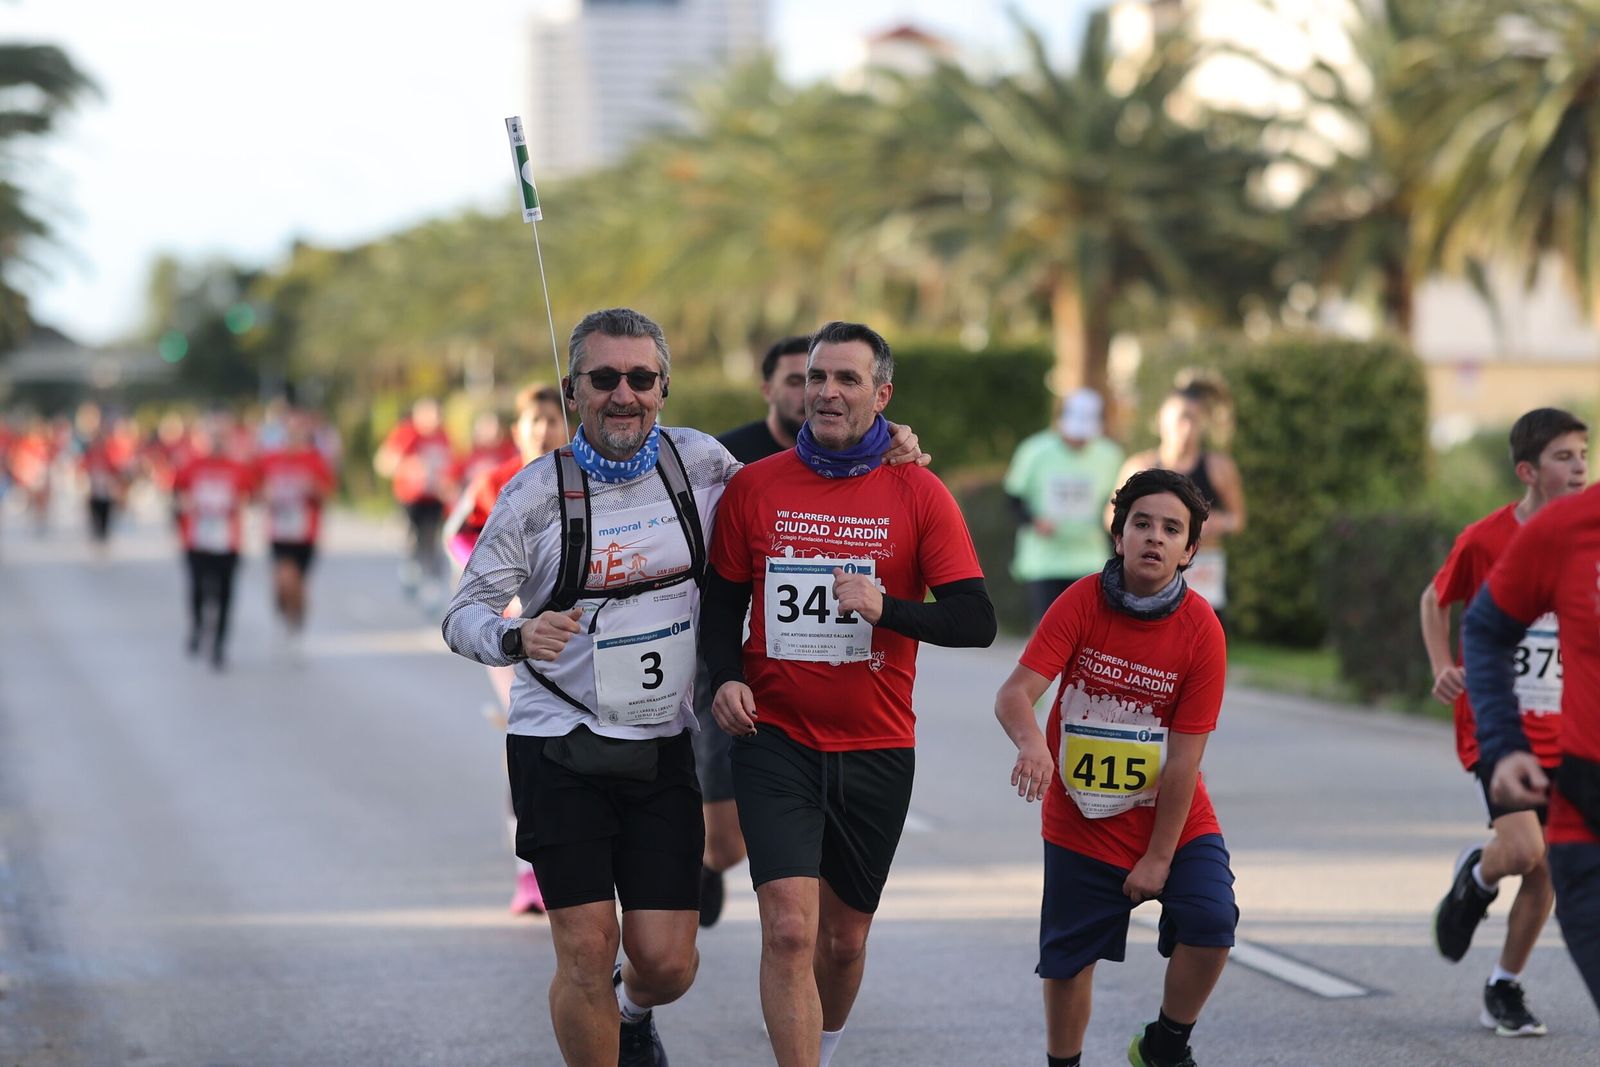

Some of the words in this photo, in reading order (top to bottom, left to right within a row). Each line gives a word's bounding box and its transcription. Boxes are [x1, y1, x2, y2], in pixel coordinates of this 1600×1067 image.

[777, 510, 790, 519] VIII
[791, 511, 836, 523] CARRERA
[838, 516, 876, 525] URBANA
[598, 521, 642, 537] mayoral
[775, 520, 830, 536] CIUDAD
[834, 526, 888, 540] JARDÍN
[797, 535, 824, 543] Fundación
[611, 598, 639, 607] ACER
[640, 651, 664, 690] 3
[1130, 662, 1165, 678] URBANA
[1166, 672, 1178, 680] DE
[1124, 672, 1175, 694] JARDÍN
[1072, 753, 1147, 791] 415
